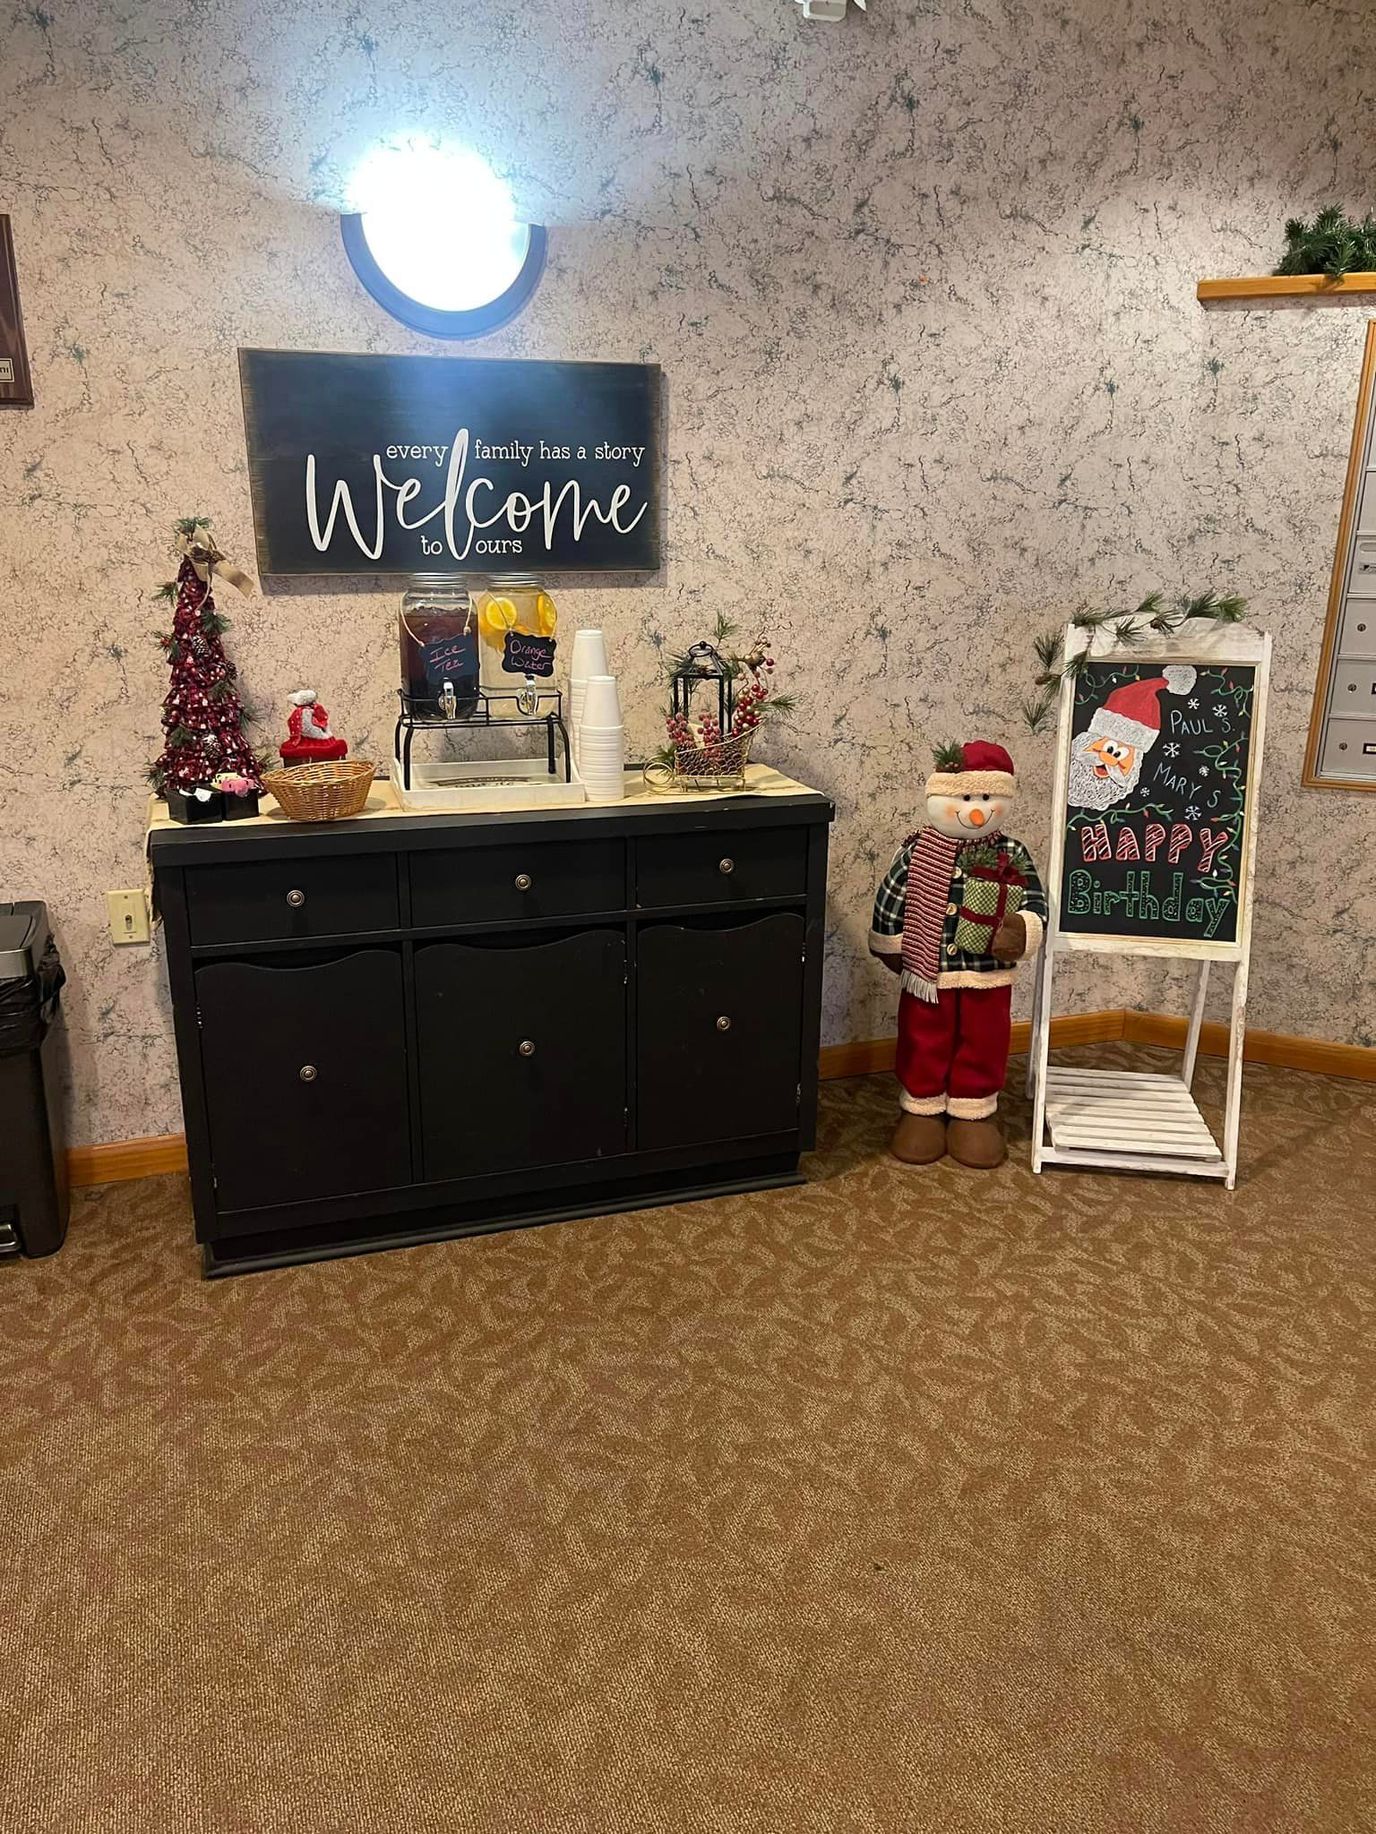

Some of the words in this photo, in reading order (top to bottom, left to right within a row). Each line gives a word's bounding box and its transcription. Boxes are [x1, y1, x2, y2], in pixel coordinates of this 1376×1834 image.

[386, 444, 448, 467] every
[474, 439, 534, 467] family
[539, 441, 571, 460] has
[576, 446, 587, 460] a
[595, 441, 646, 467] story
[305, 428, 648, 561] Welcome
[420, 536, 443, 556] to
[475, 538, 523, 555] ours
[430, 645, 466, 662] Ice
[510, 639, 552, 661] Orange
[511, 656, 552, 670] Water
[434, 659, 464, 672] Tea
[1170, 709, 1214, 736] PAUL
[1153, 761, 1203, 800] MARY
[1206, 790, 1222, 808] S
[1081, 823, 1229, 872] HAPPY
[1067, 869, 1231, 938] Birthday
